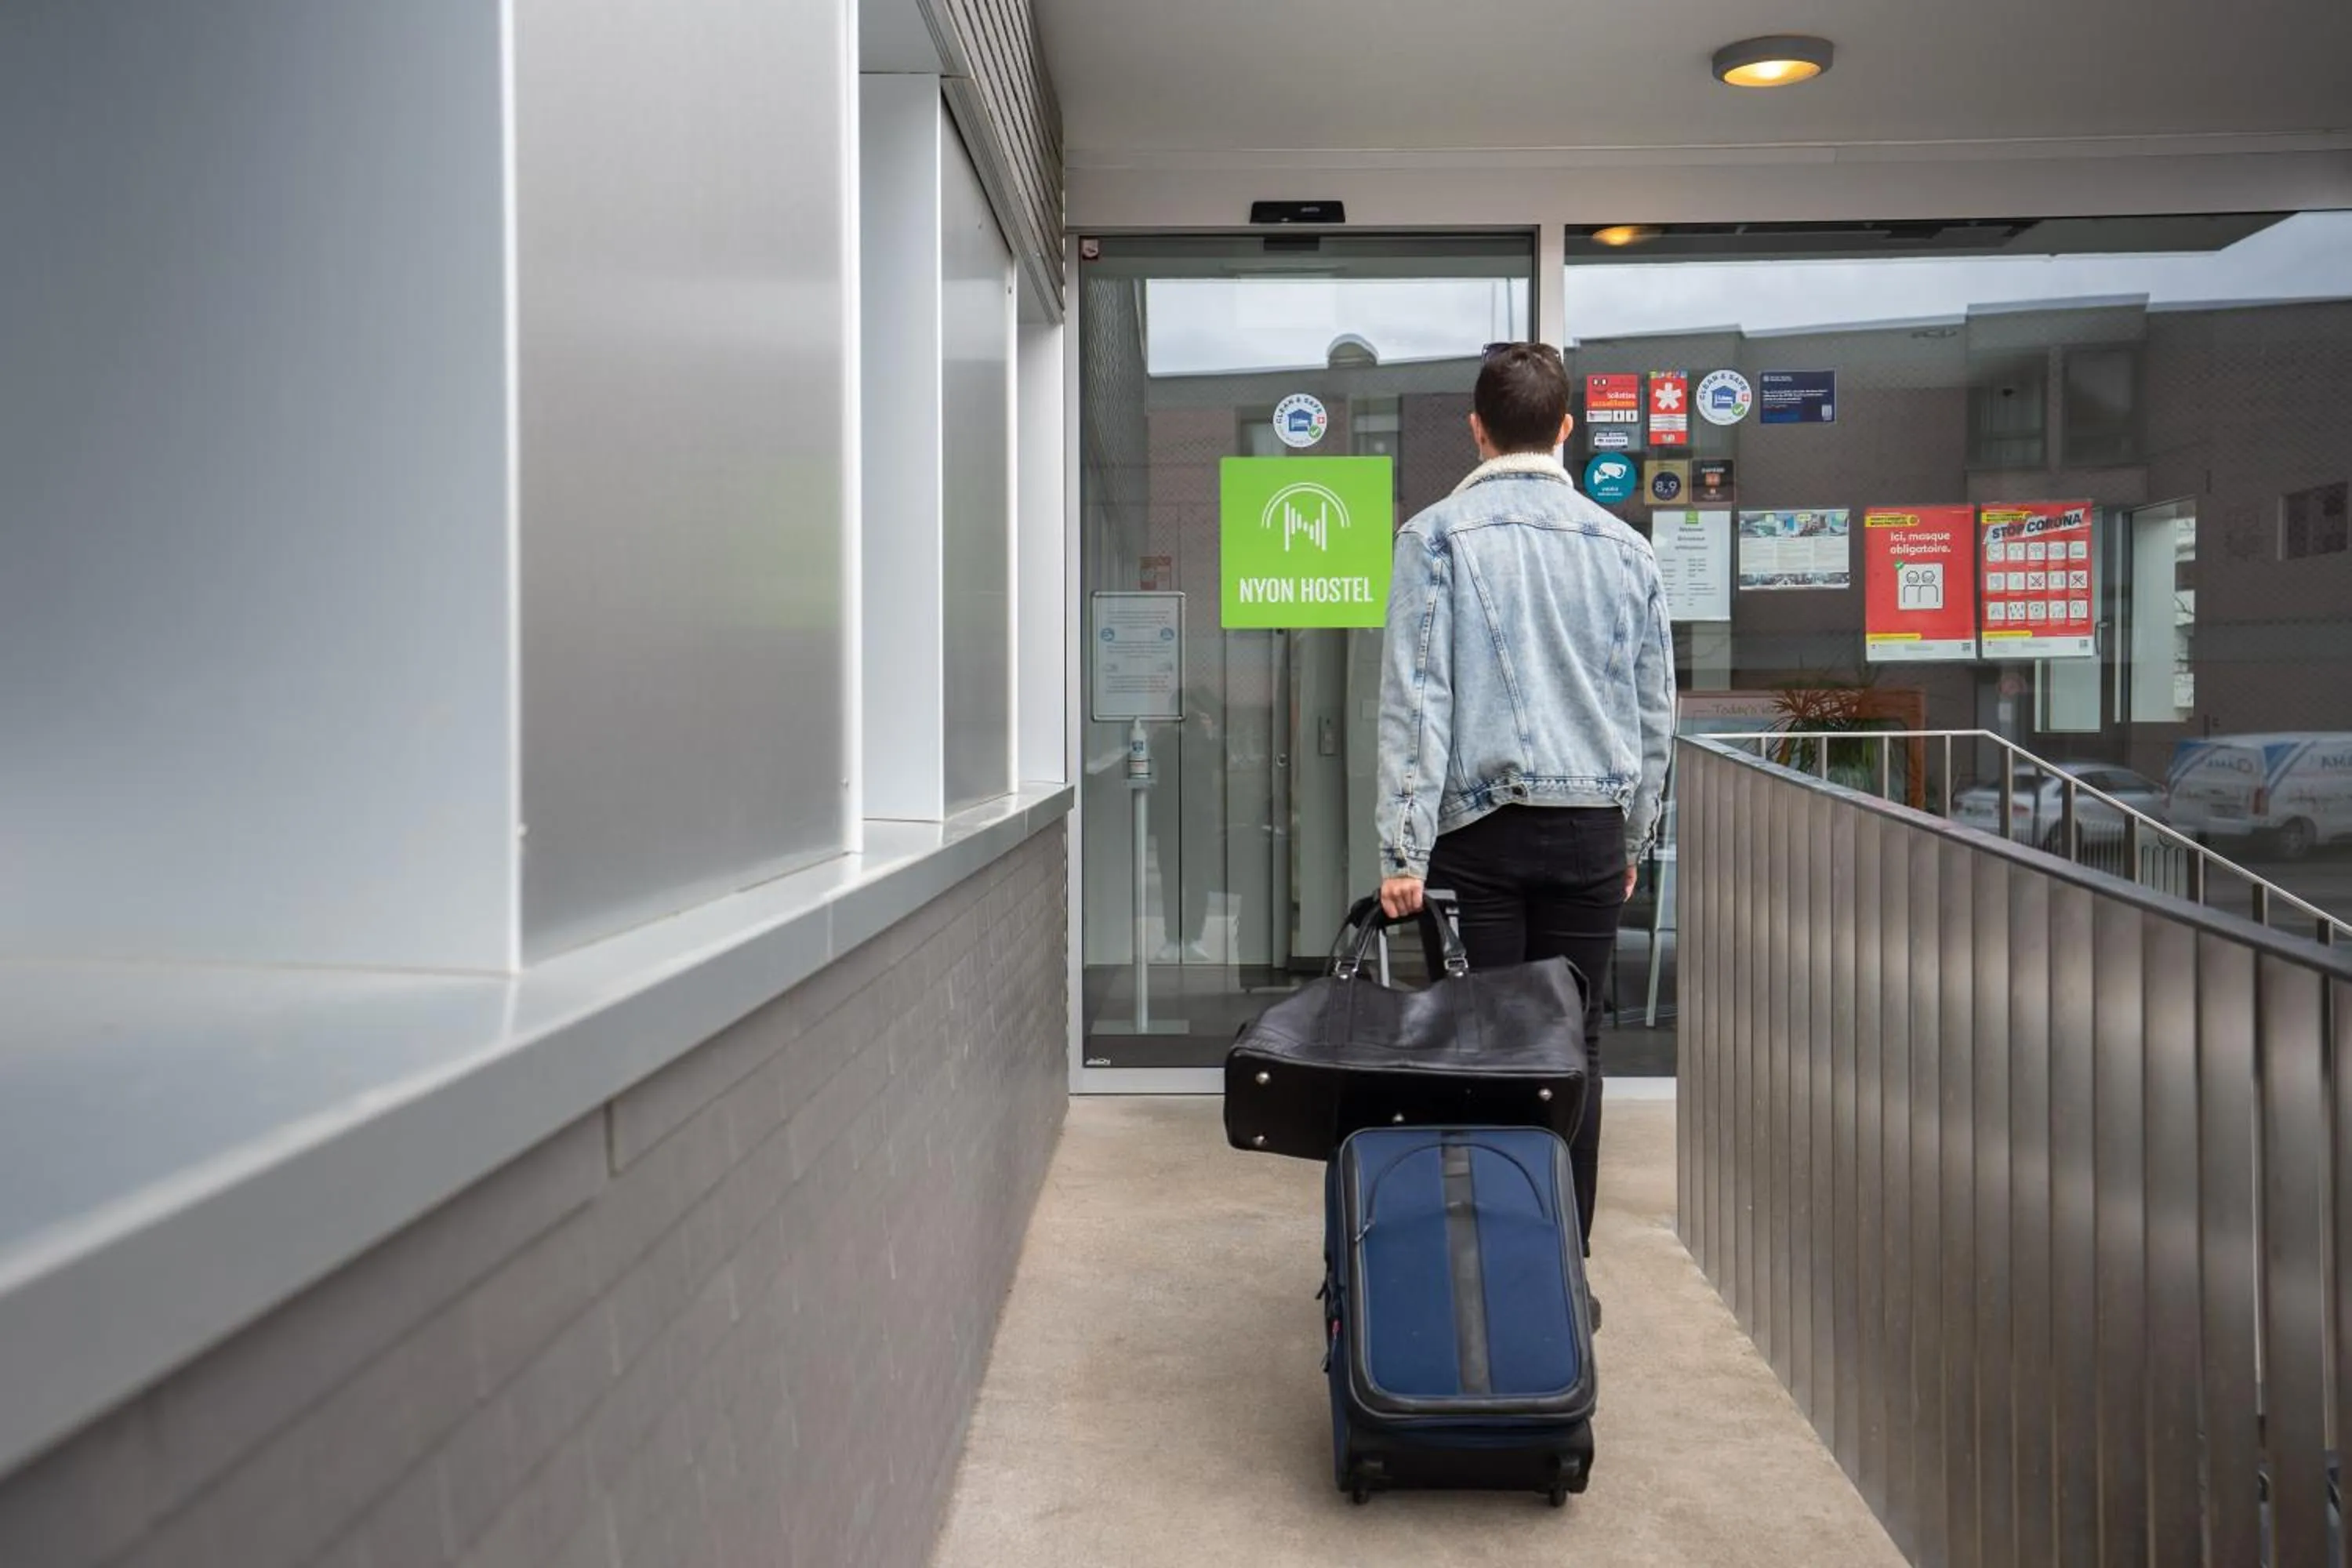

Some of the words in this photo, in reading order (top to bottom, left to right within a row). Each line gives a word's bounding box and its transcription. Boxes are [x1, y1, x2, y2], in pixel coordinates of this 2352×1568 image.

[1276, 398, 1294, 424] CLEAN
[1304, 397, 1322, 414] SAFE
[1655, 480, 1678, 494] 8,9
[1992, 524, 2024, 539] STOP
[2027, 513, 2082, 533] CORONA
[1890, 532, 1907, 543] Ici,
[1908, 532, 1951, 543] masque
[1889, 543, 1951, 557] obligatoire.
[1240, 576, 1294, 604] NYON
[1300, 576, 1374, 604] HOSTEL
